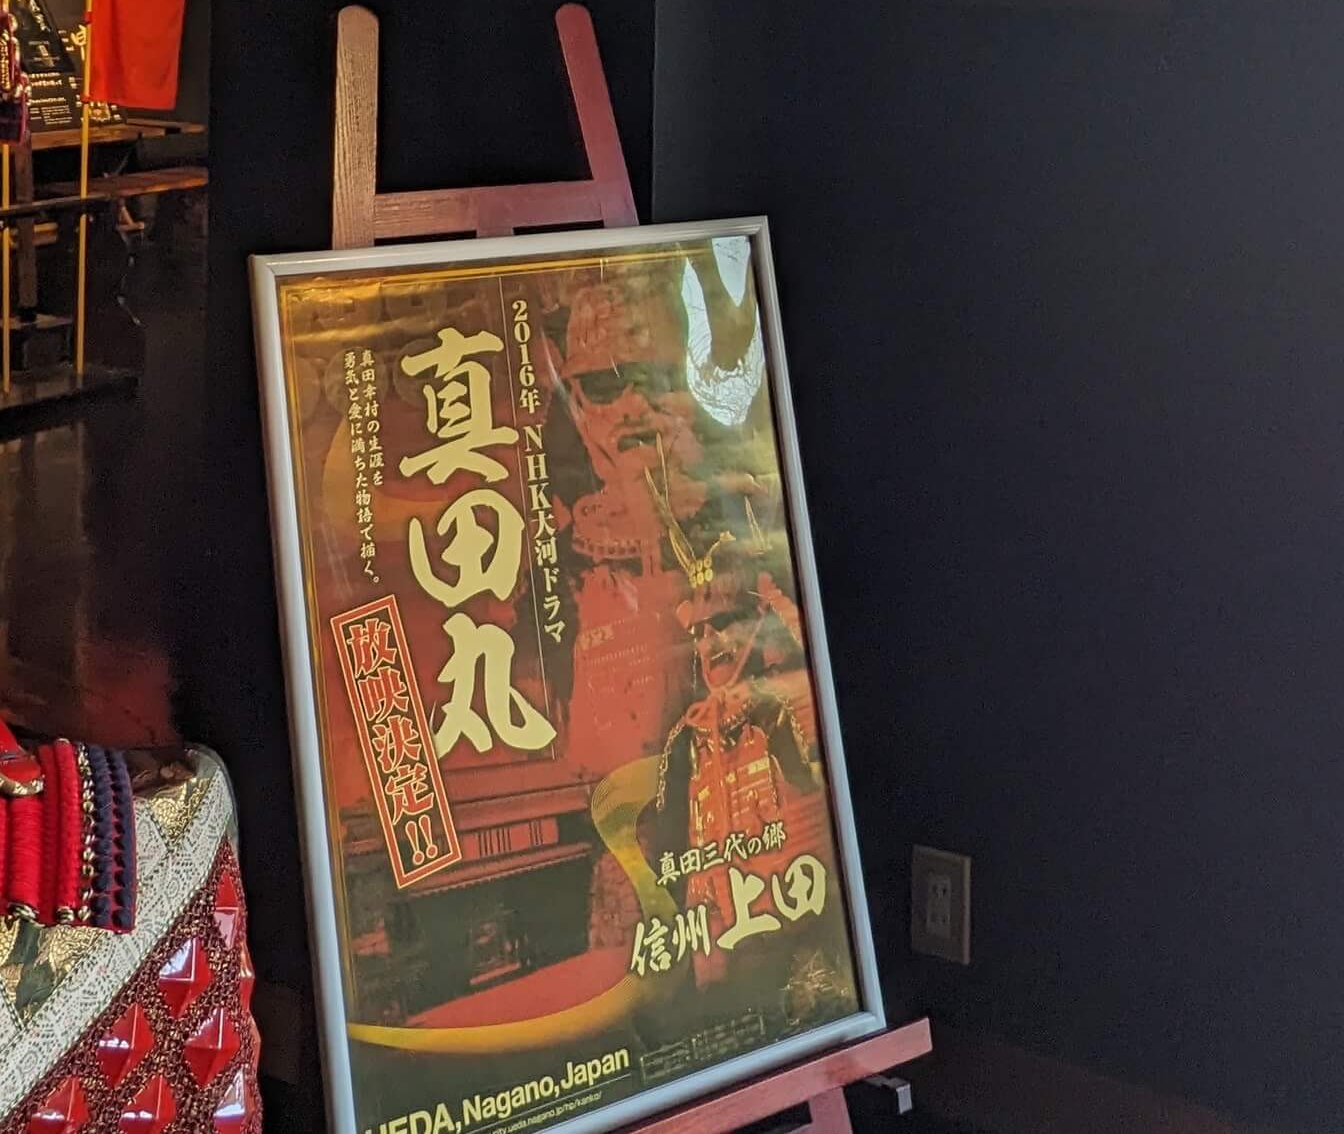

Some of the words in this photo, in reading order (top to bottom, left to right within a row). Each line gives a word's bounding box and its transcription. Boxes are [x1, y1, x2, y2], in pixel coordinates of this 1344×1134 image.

[400, 327, 558, 758] 真田丸
[657, 821, 787, 886] 真田三代の郷
